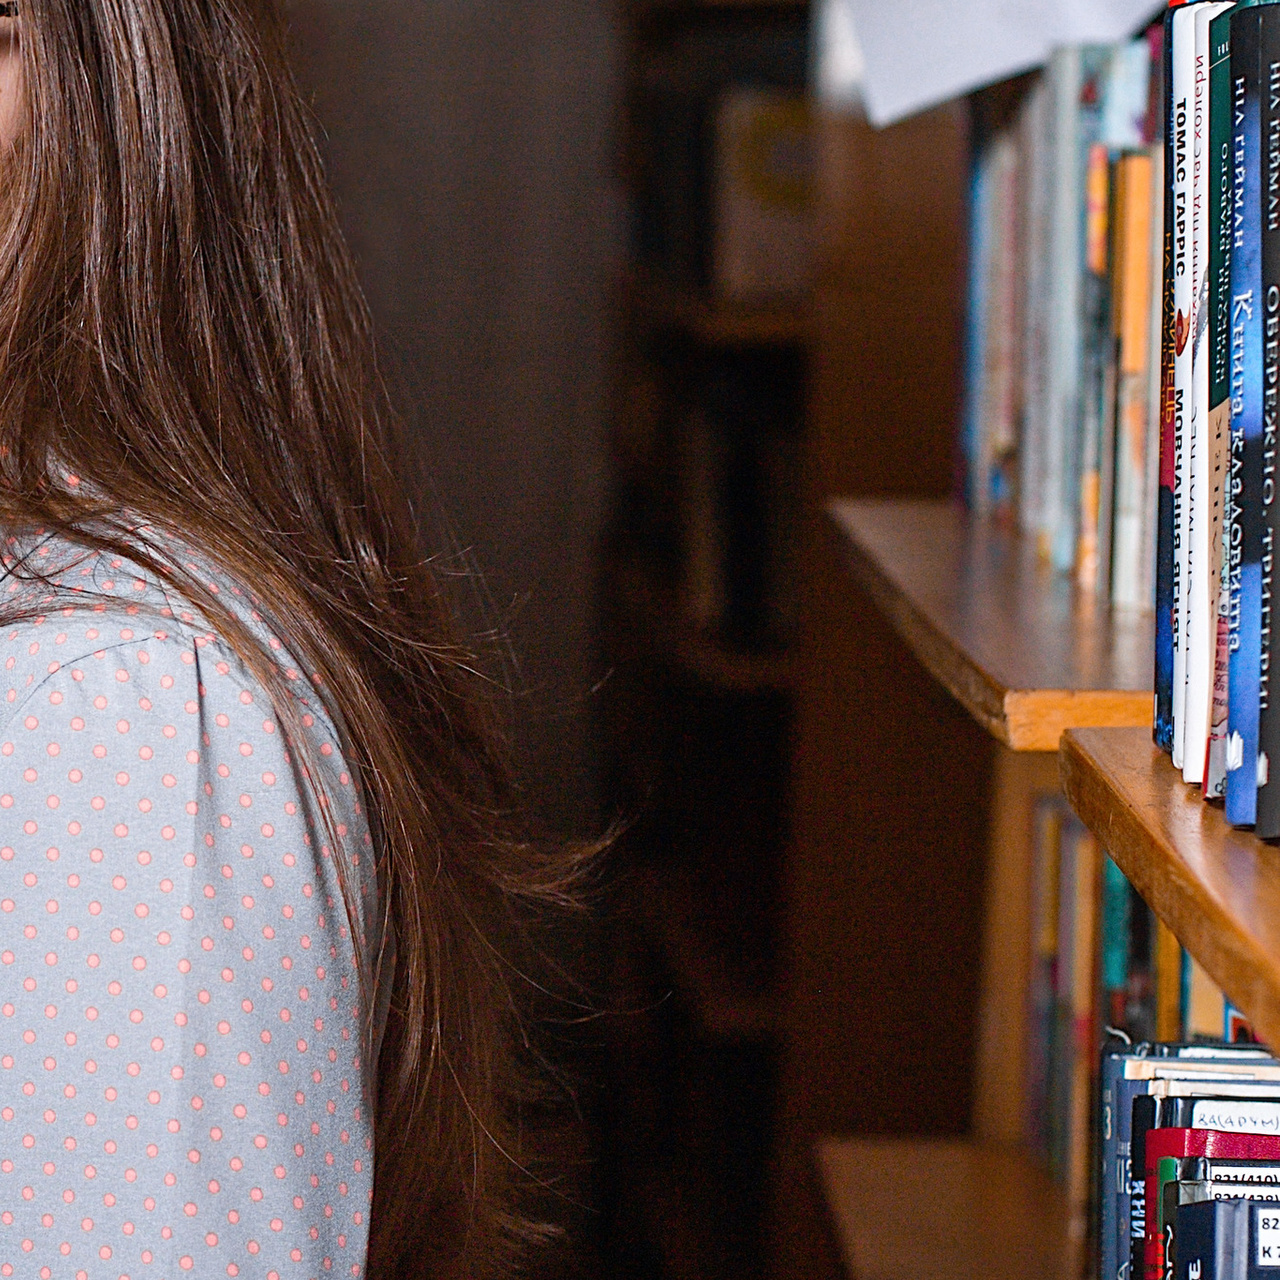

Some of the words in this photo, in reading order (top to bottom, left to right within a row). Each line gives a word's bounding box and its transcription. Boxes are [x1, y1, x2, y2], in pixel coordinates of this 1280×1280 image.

[1175, 97, 1187, 183] ТОМАС
[1234, 76, 1245, 127] НІЛ
[1175, 191, 1187, 278] ГАРРІС
[1173, 388, 1185, 550] МОВЧАННЯ
